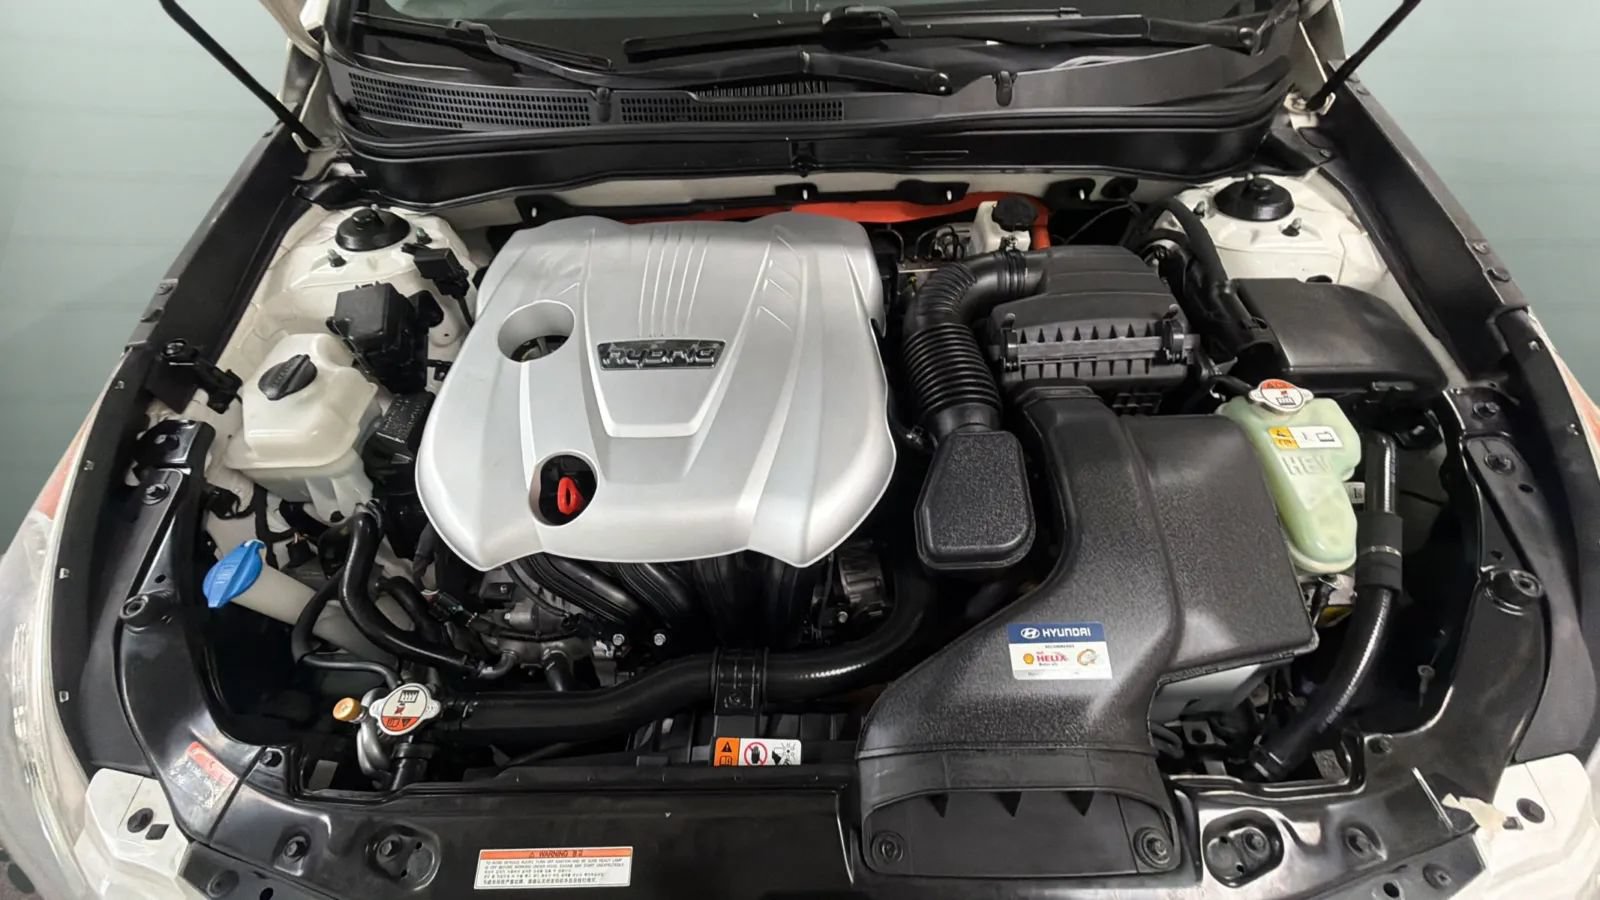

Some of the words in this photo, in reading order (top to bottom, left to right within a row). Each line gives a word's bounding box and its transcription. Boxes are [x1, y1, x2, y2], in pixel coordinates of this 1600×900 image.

[1281, 455, 1334, 475] HEV
[1042, 627, 1092, 638] HYUNDAI
[539, 850, 569, 858] WARNING
